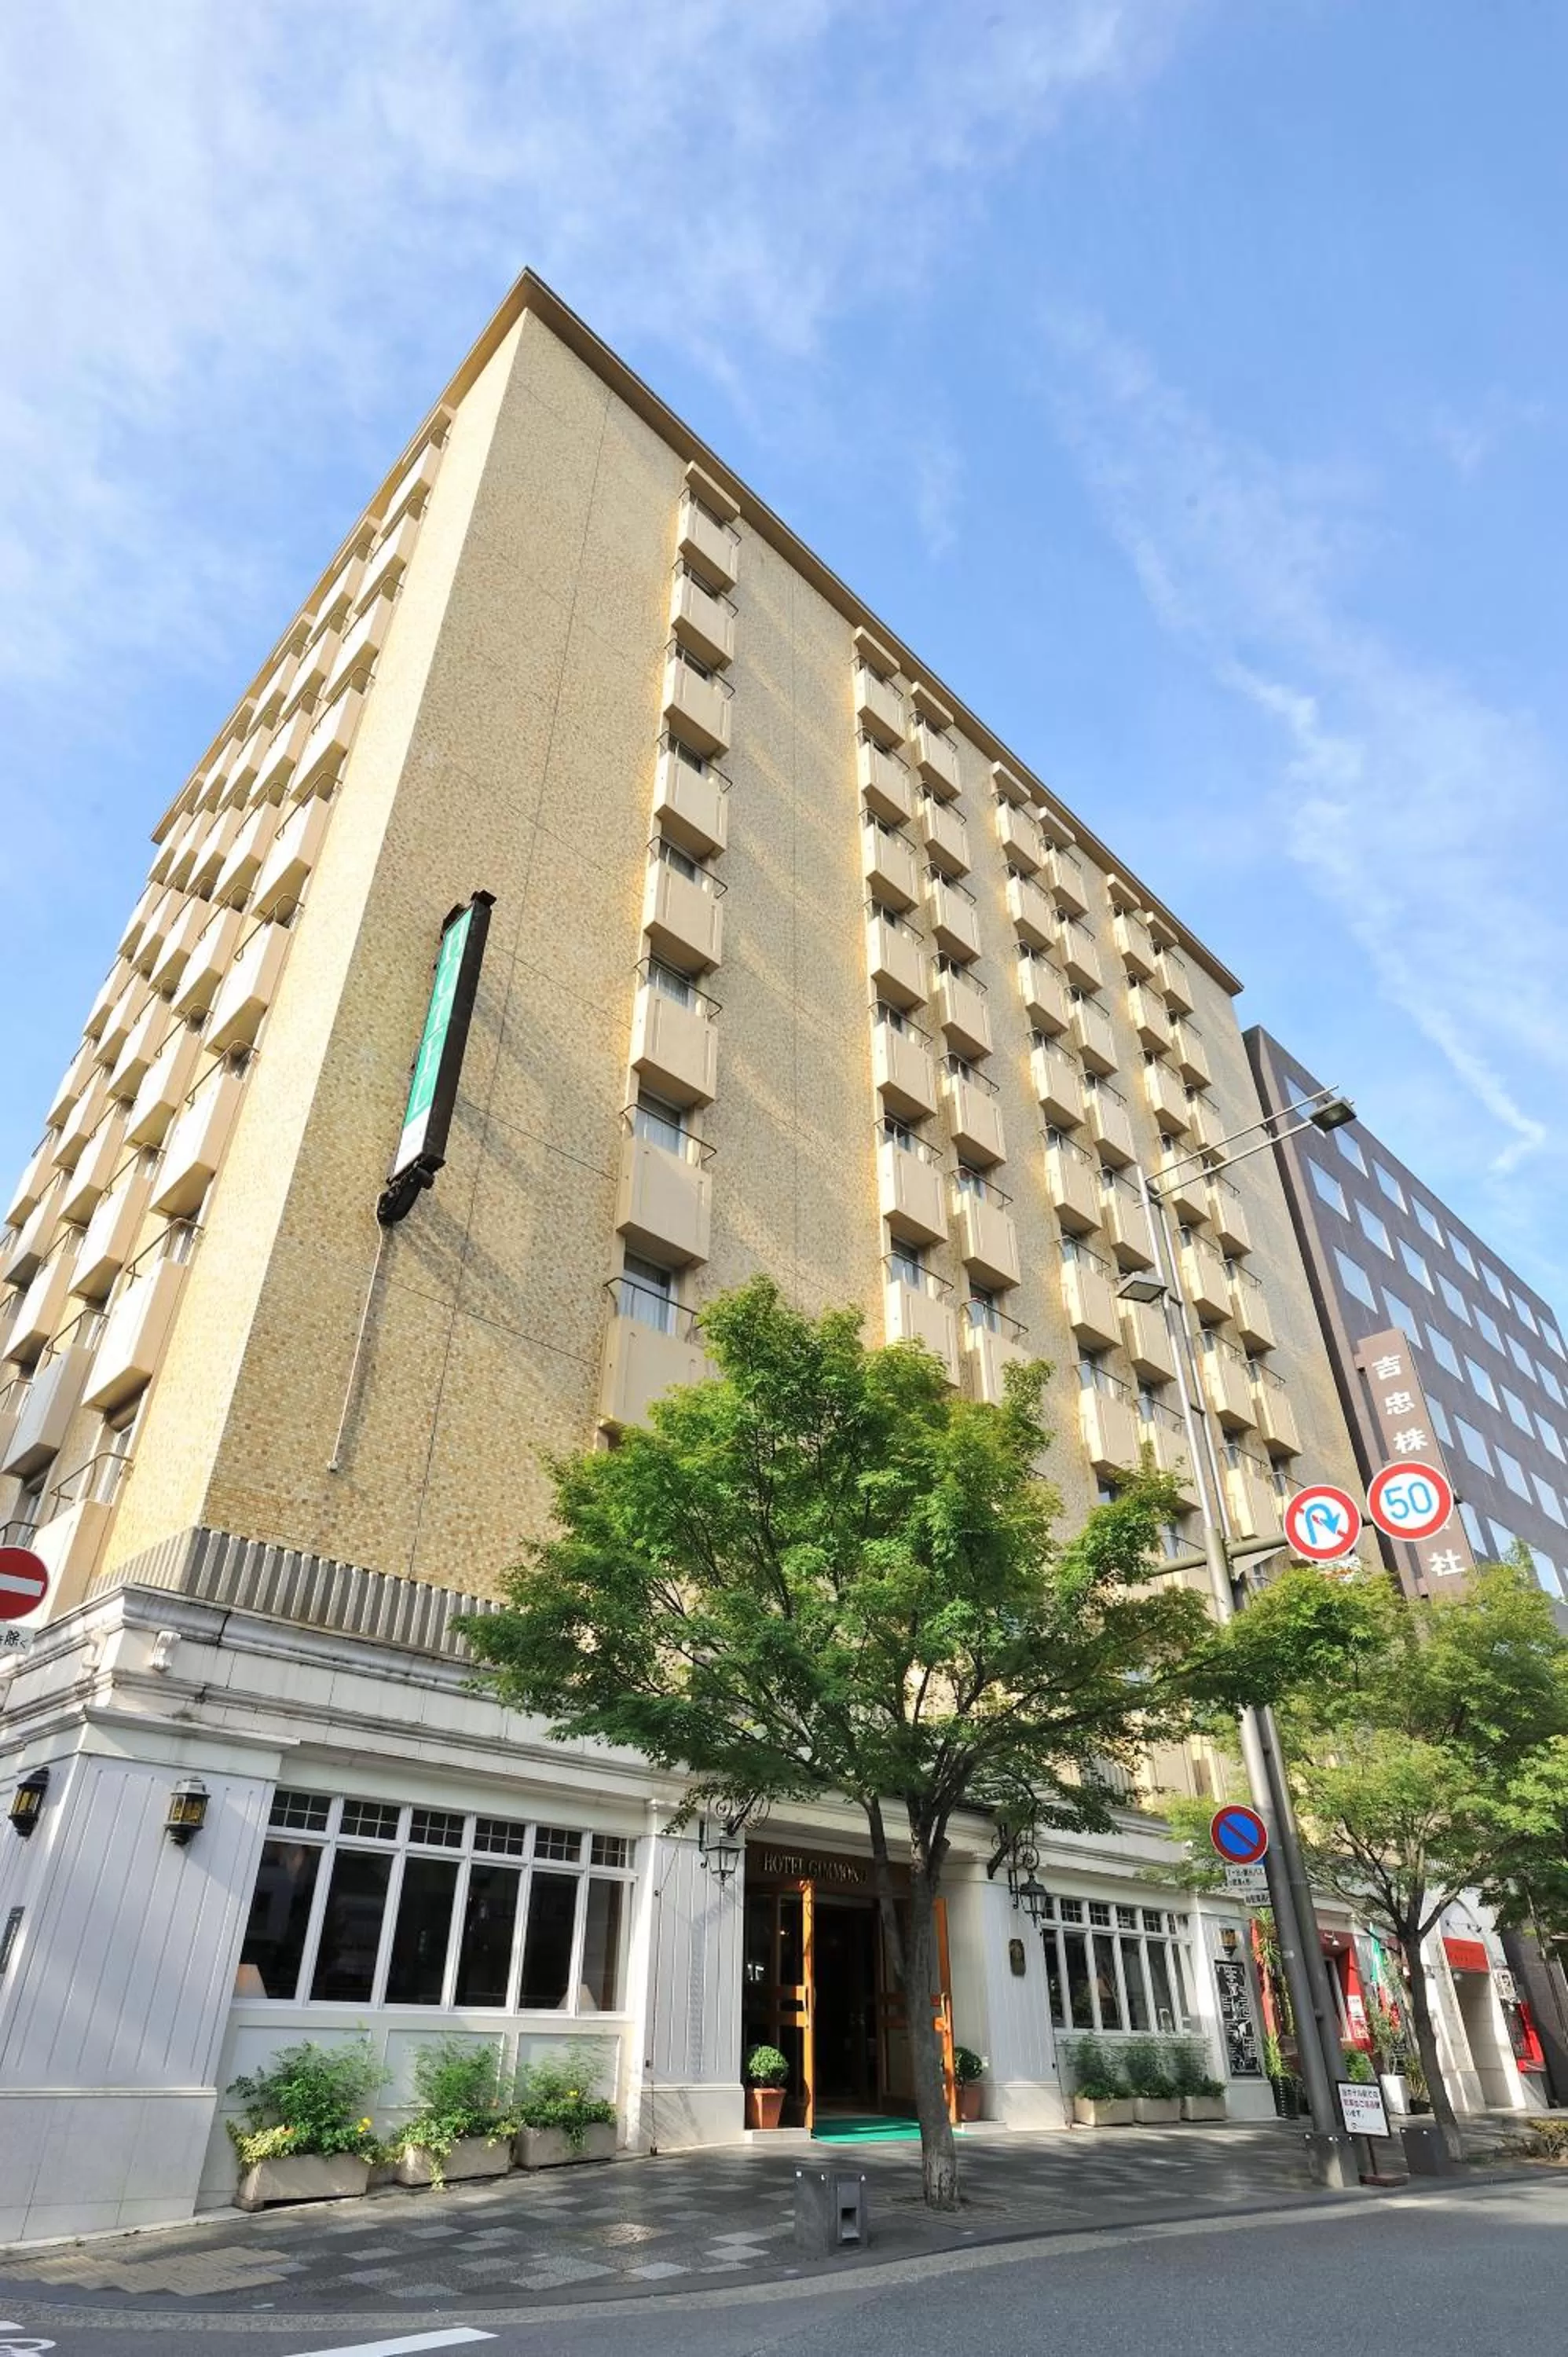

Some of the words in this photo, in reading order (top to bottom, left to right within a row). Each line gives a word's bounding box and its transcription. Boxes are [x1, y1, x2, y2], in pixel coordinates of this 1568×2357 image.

[1372, 1354, 1465, 1577] 吉忠株社
[1384, 1482, 1432, 1519] 50
[0, 1629, 29, 1648] 除く
[764, 1852, 804, 1875] HOTEL
